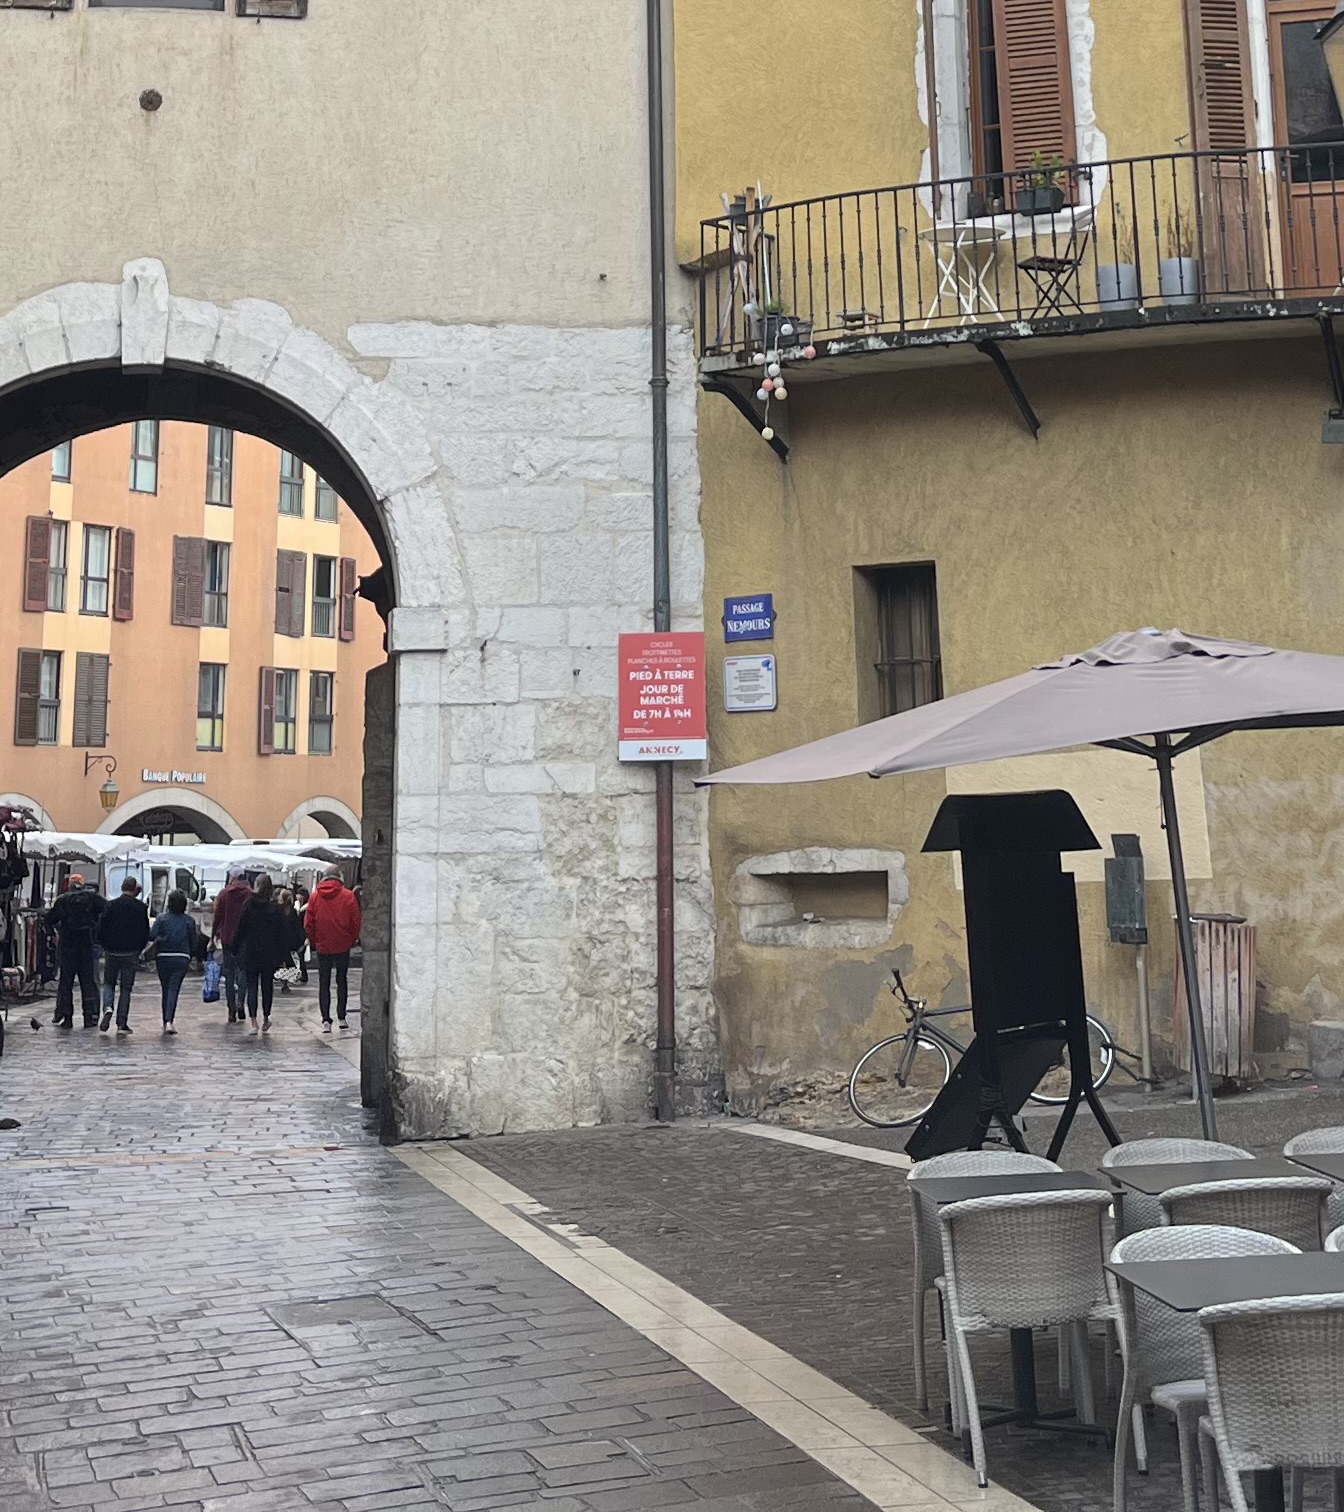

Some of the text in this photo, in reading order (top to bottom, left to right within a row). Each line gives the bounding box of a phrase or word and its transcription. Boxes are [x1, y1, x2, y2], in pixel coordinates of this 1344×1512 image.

[732, 602, 764, 615] PASSAGE
[727, 618, 771, 633] NEMOURS
[629, 668, 694, 680] PIED À TERRE
[640, 684, 684, 694] JOUR DE
[640, 693, 684, 705] MARCHÉ
[633, 707, 691, 719] DE 7H À 14H
[639, 745, 680, 755] ANNECY
[142, 768, 207, 784] BANQUE POPULAIRE
